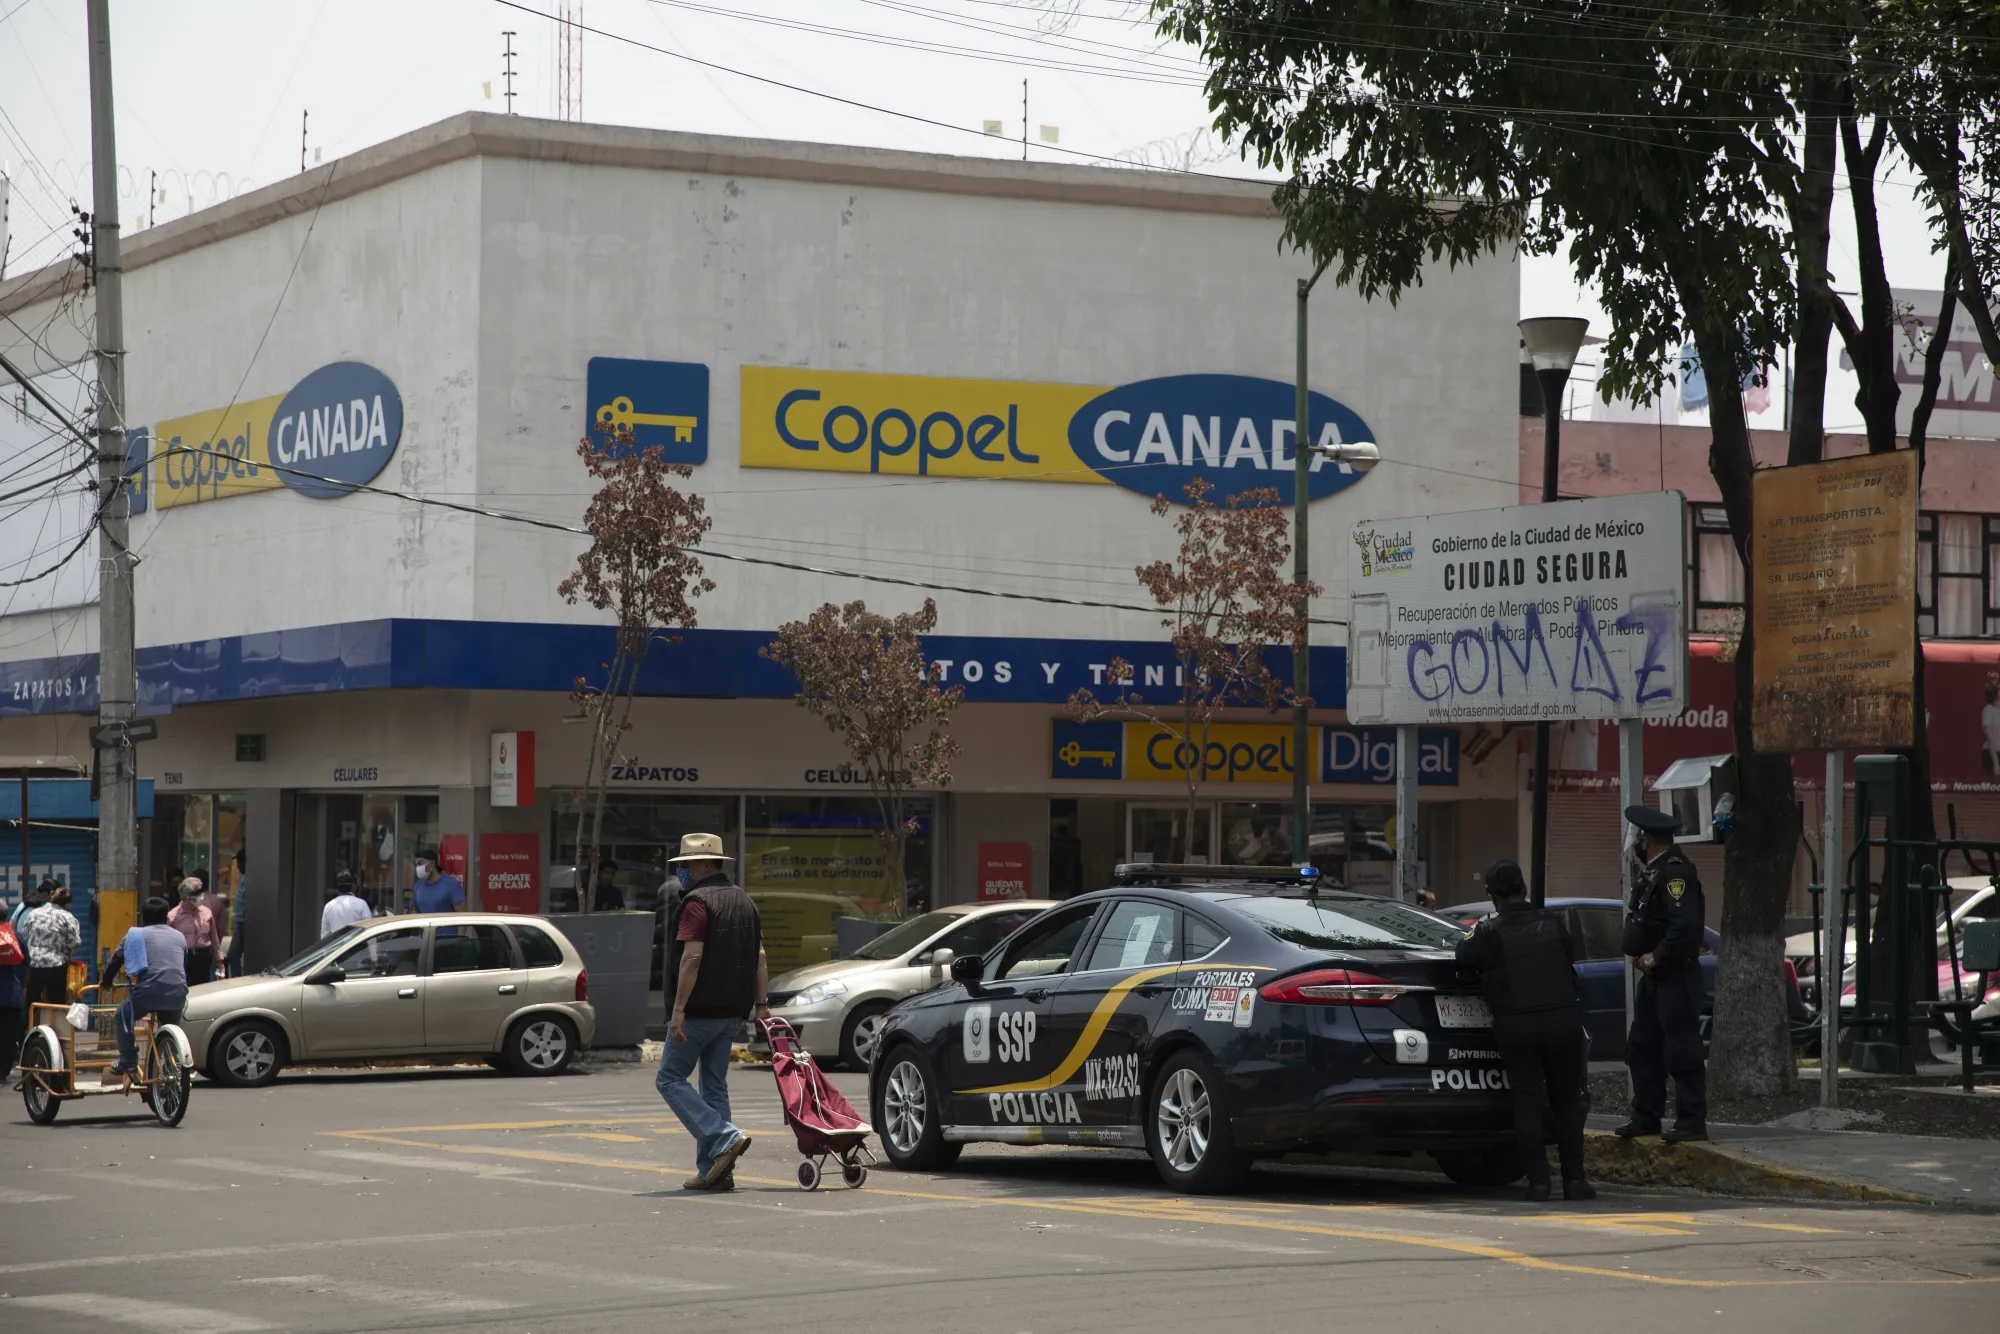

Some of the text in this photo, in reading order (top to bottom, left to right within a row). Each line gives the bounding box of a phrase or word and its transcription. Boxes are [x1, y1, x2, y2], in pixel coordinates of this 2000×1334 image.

[277, 395, 387, 464] CANADA
[774, 389, 1040, 476] Coppel
[1092, 410, 1354, 476] CANADA
[165, 421, 258, 503] Coppel
[1373, 530, 1412, 550] Ciudad
[1432, 519, 1645, 554] Gobierno de la Ciudad de México
[1444, 550, 1628, 591] CIUDAD SEGURA
[1768, 574, 1785, 585] SR.
[1398, 594, 1618, 625] Recuperación de Mercados Públicos
[1378, 628, 1454, 650] Mejoramiento
[1549, 621, 1581, 639] Poda
[1586, 627, 1594, 642] y
[1599, 619, 1645, 637] Pintura
[1040, 662, 1061, 684] Y
[13, 677, 72, 701] ZAPATOS
[80, 676, 88, 696] Y
[1428, 703, 1577, 720] www.obrasenmiciudad.df.gob.mx
[1146, 732, 1295, 782] Coppel
[1330, 731, 1452, 783] Digal
[164, 772, 183, 785] TENIS
[333, 767, 378, 781] CELULARES
[611, 766, 699, 783] ZAPATOS
[804, 768, 912, 784] CELULAES
[510, 852, 530, 860] Vidas
[761, 854, 777, 866] En
[780, 855, 808, 866] este
[488, 871, 531, 882] QUÉDATE
[804, 869, 819, 879] es
[488, 881, 532, 890] EN CASA
[985, 887, 998, 896] EN
[1193, 971, 1256, 987] PORTALES
[1171, 987, 1235, 1010] CDMX 911
[998, 1011, 1037, 1063] SSP
[1085, 1052, 1141, 1101] MX-322-S2
[1431, 1068, 1511, 1090] POLICI
[988, 1092, 1082, 1124] POLICIA
